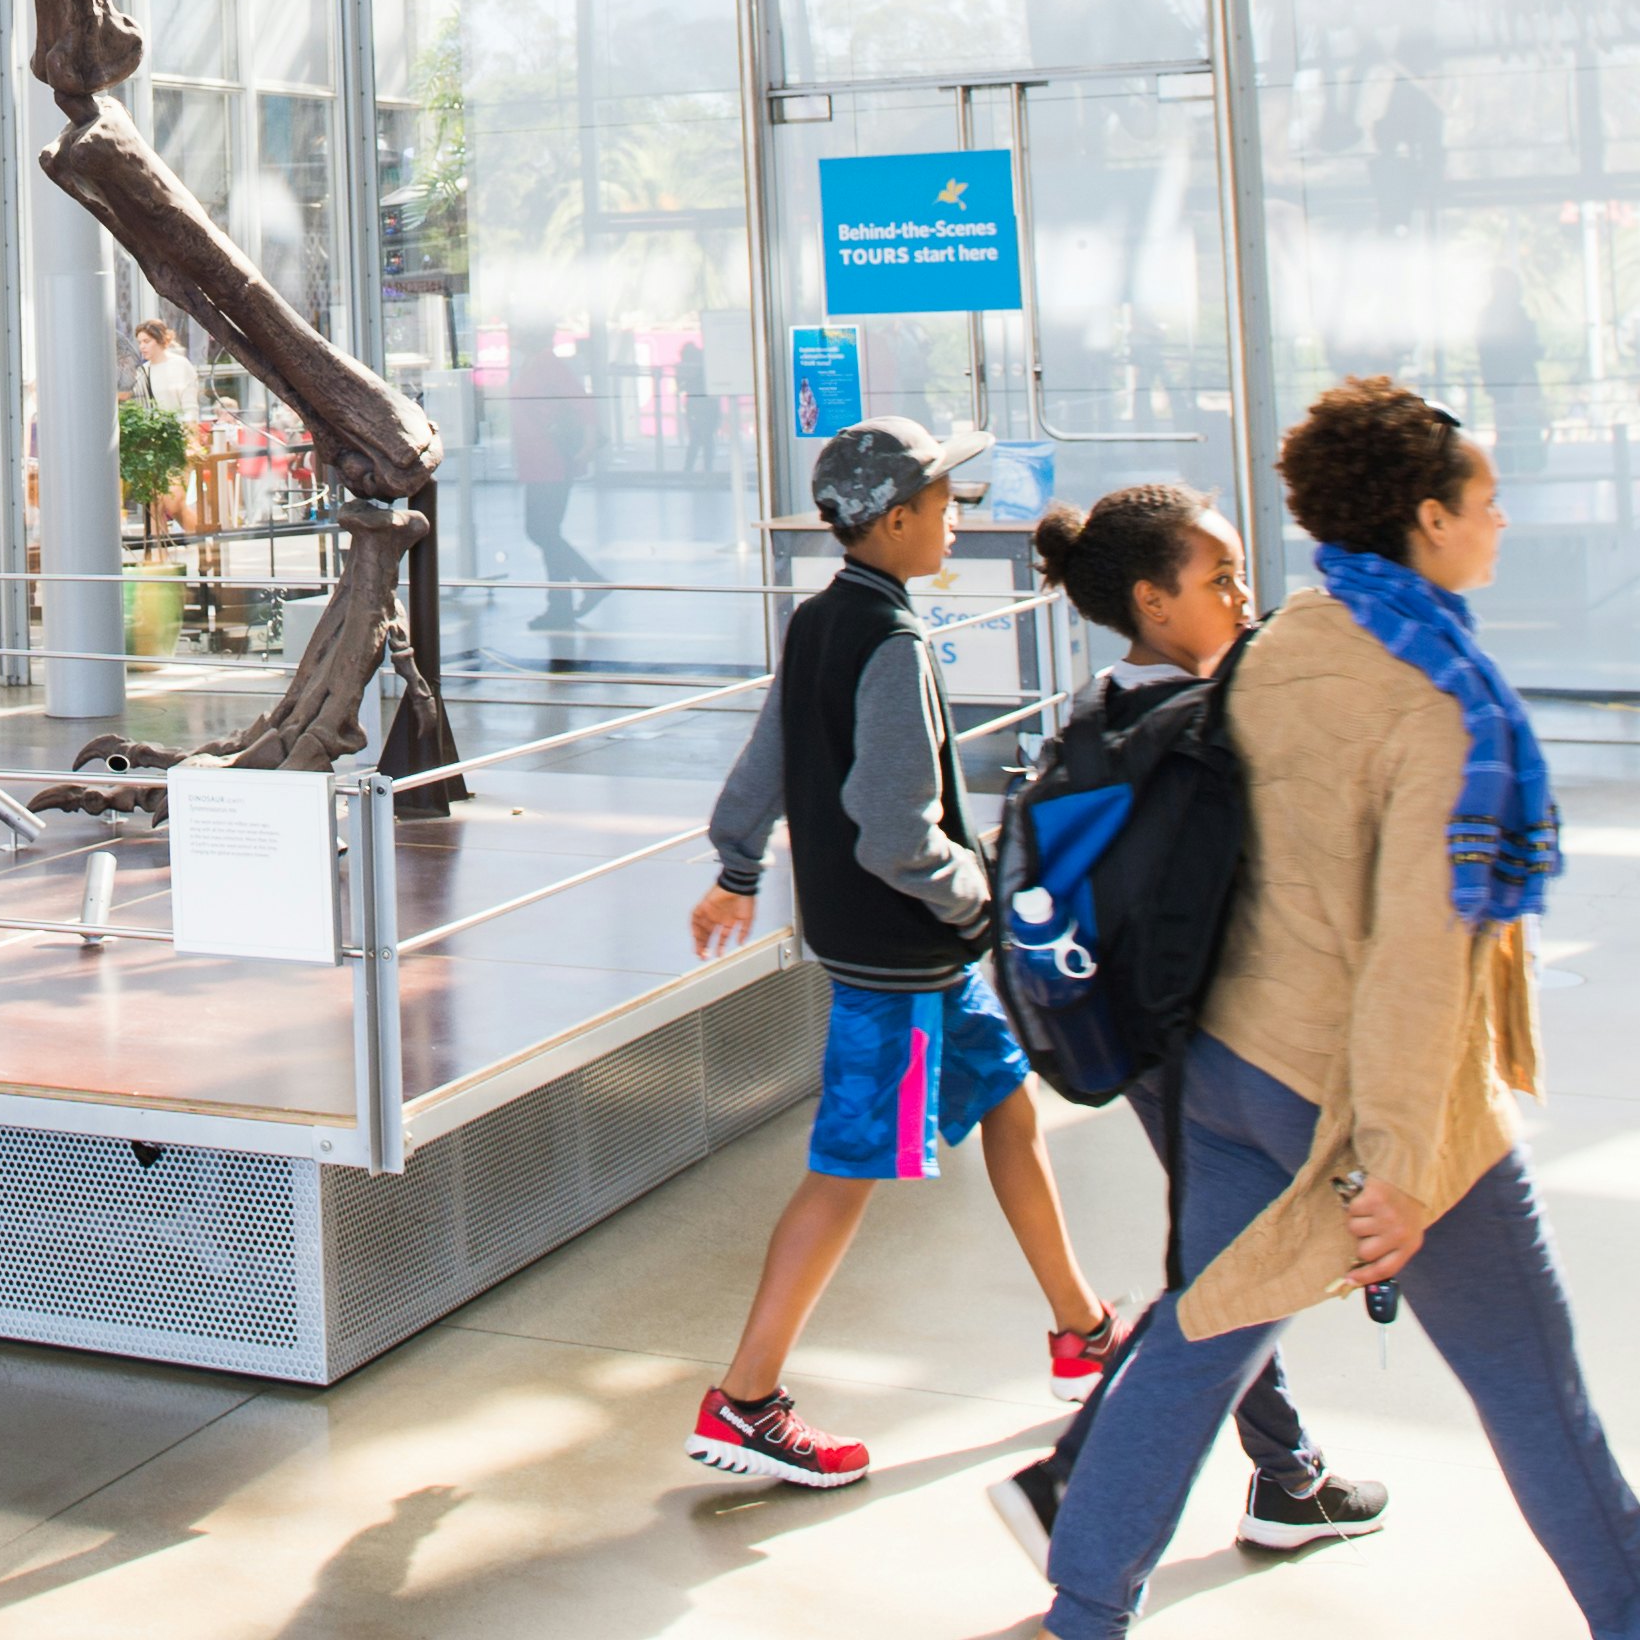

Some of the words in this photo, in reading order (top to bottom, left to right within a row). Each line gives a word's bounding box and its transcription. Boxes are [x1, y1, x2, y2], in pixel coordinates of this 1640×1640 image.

[838, 220, 997, 241] Behind-the-Scenes
[839, 247, 910, 265] TOURS
[914, 246, 956, 263] start
[958, 244, 999, 261] here
[719, 1405, 756, 1437] Reebok
